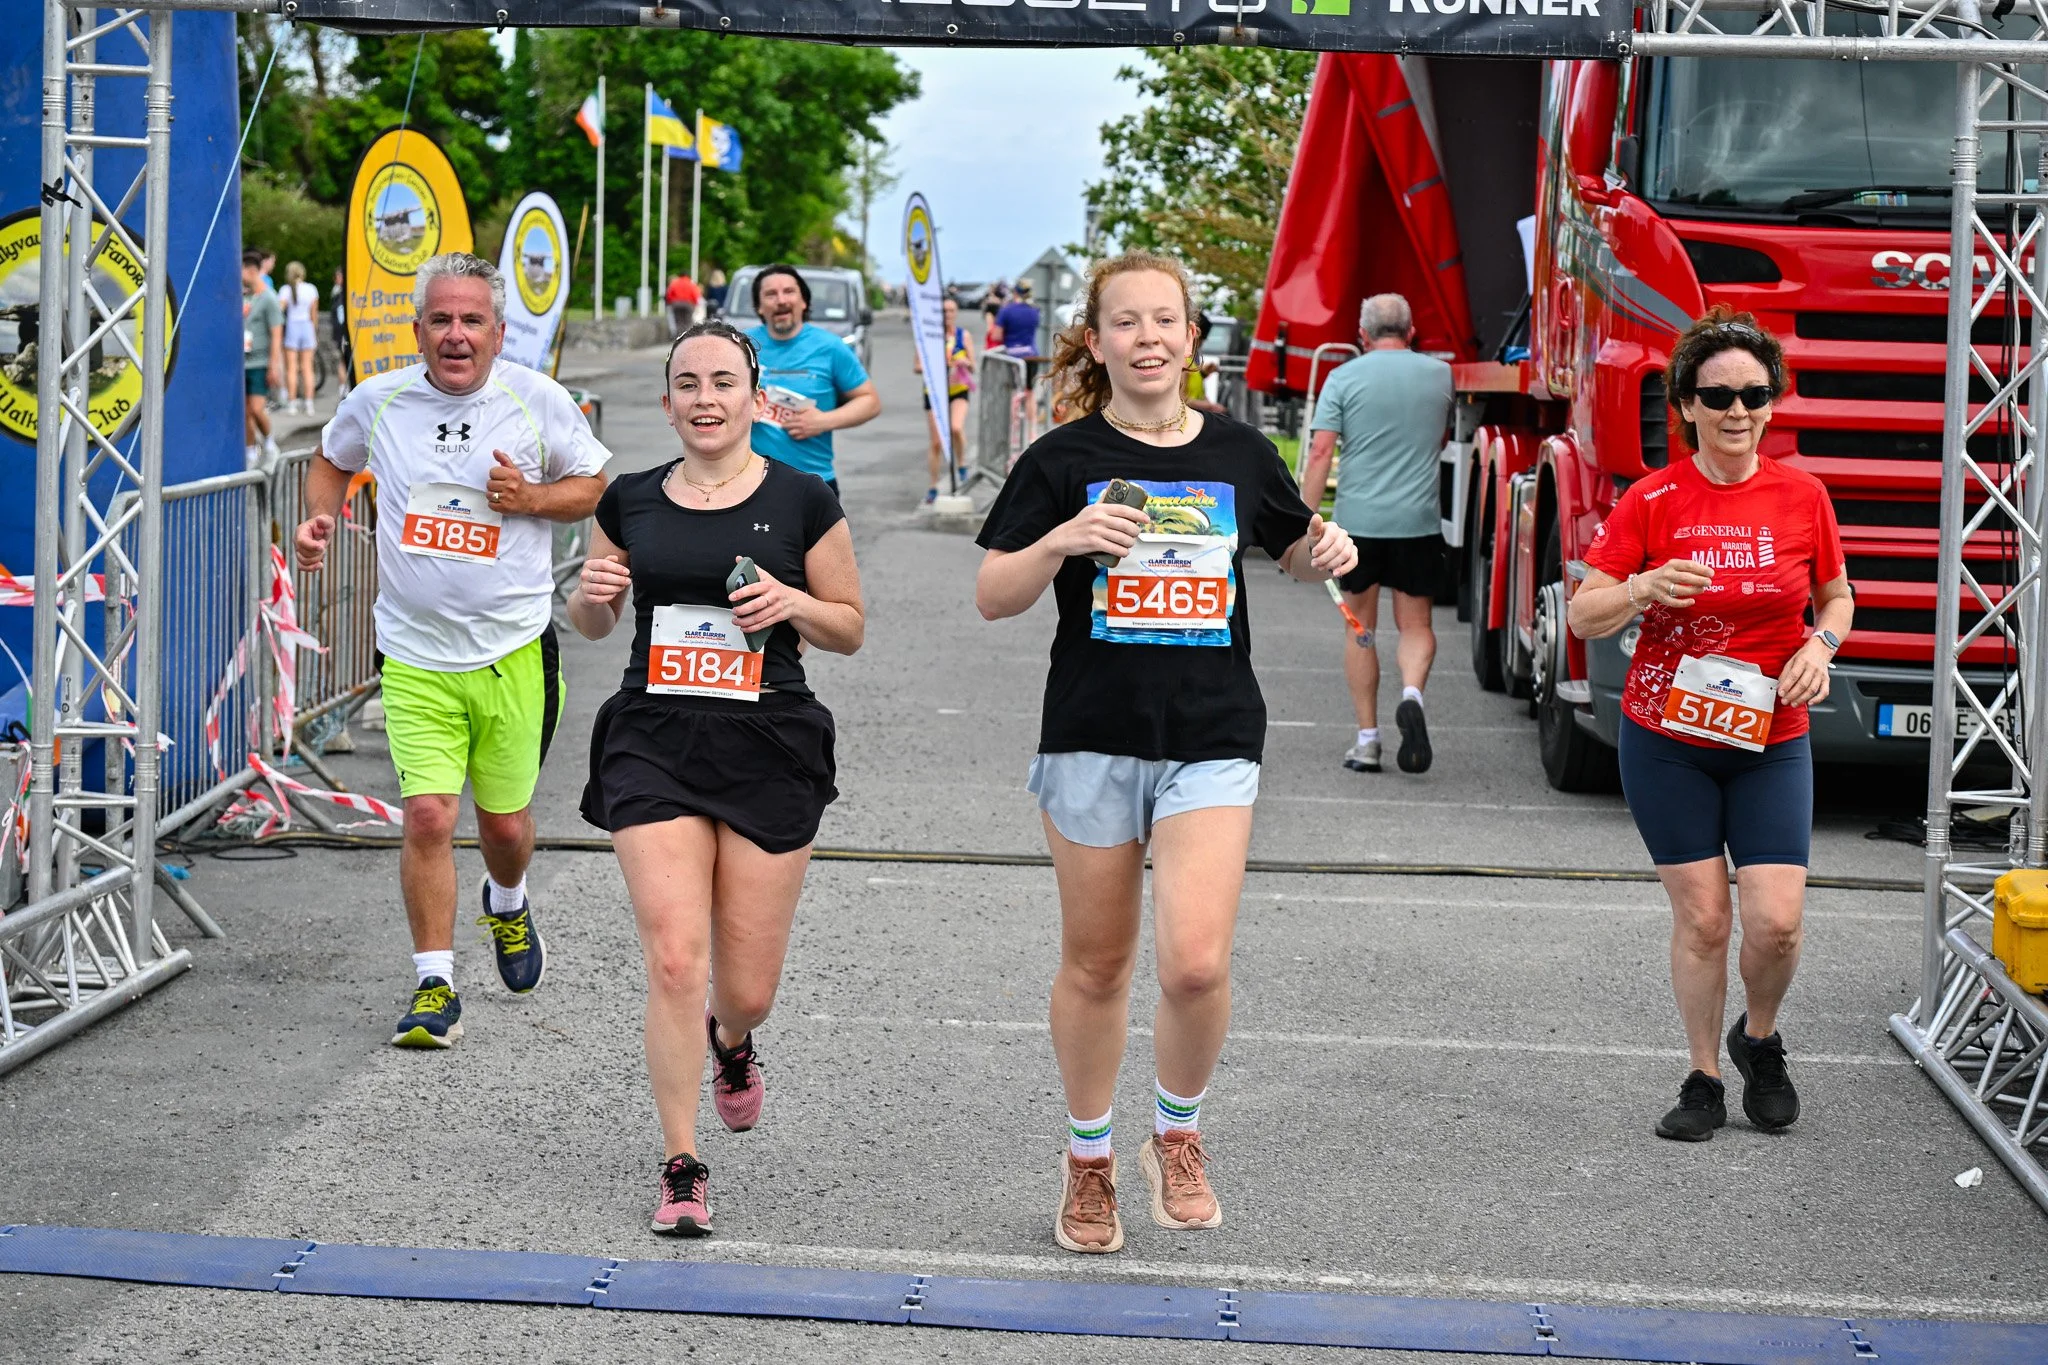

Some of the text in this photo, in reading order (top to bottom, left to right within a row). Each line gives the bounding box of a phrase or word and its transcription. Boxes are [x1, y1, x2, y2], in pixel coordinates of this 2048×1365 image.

[435, 444, 470, 453] RUN
[413, 518, 487, 552] 5185
[1691, 525, 1752, 537] GENERALI
[1691, 547, 1756, 568] MÁLAGA
[1721, 541, 1752, 551] MARATÓN
[1116, 579, 1217, 614] 5465
[661, 649, 744, 686] 5184
[1677, 694, 1757, 740] 5142
